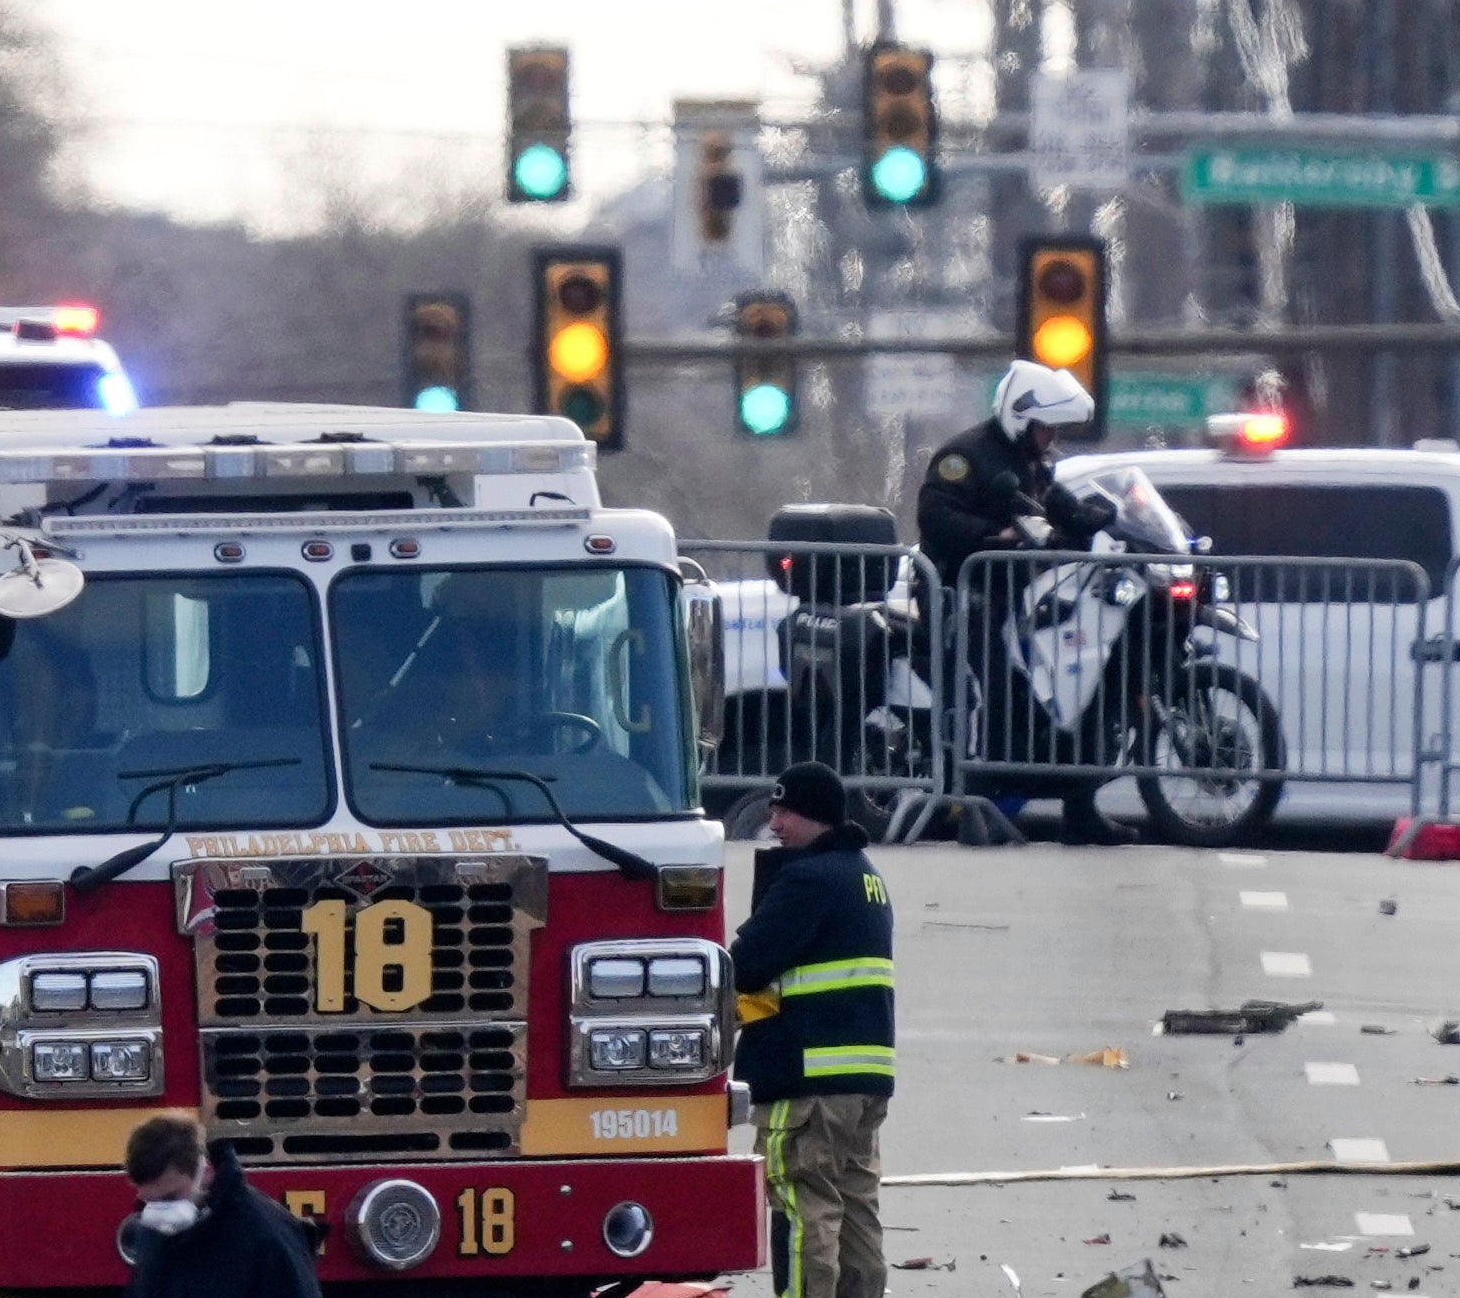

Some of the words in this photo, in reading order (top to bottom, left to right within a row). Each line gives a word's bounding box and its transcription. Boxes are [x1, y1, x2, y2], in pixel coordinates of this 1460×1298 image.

[186, 832, 372, 857] PHILADELPHIA
[381, 831, 443, 852] FIRE
[449, 830, 522, 851] DEPT.
[301, 900, 433, 1011] 18
[590, 1109, 679, 1139] 195014
[458, 1187, 515, 1255] 18
